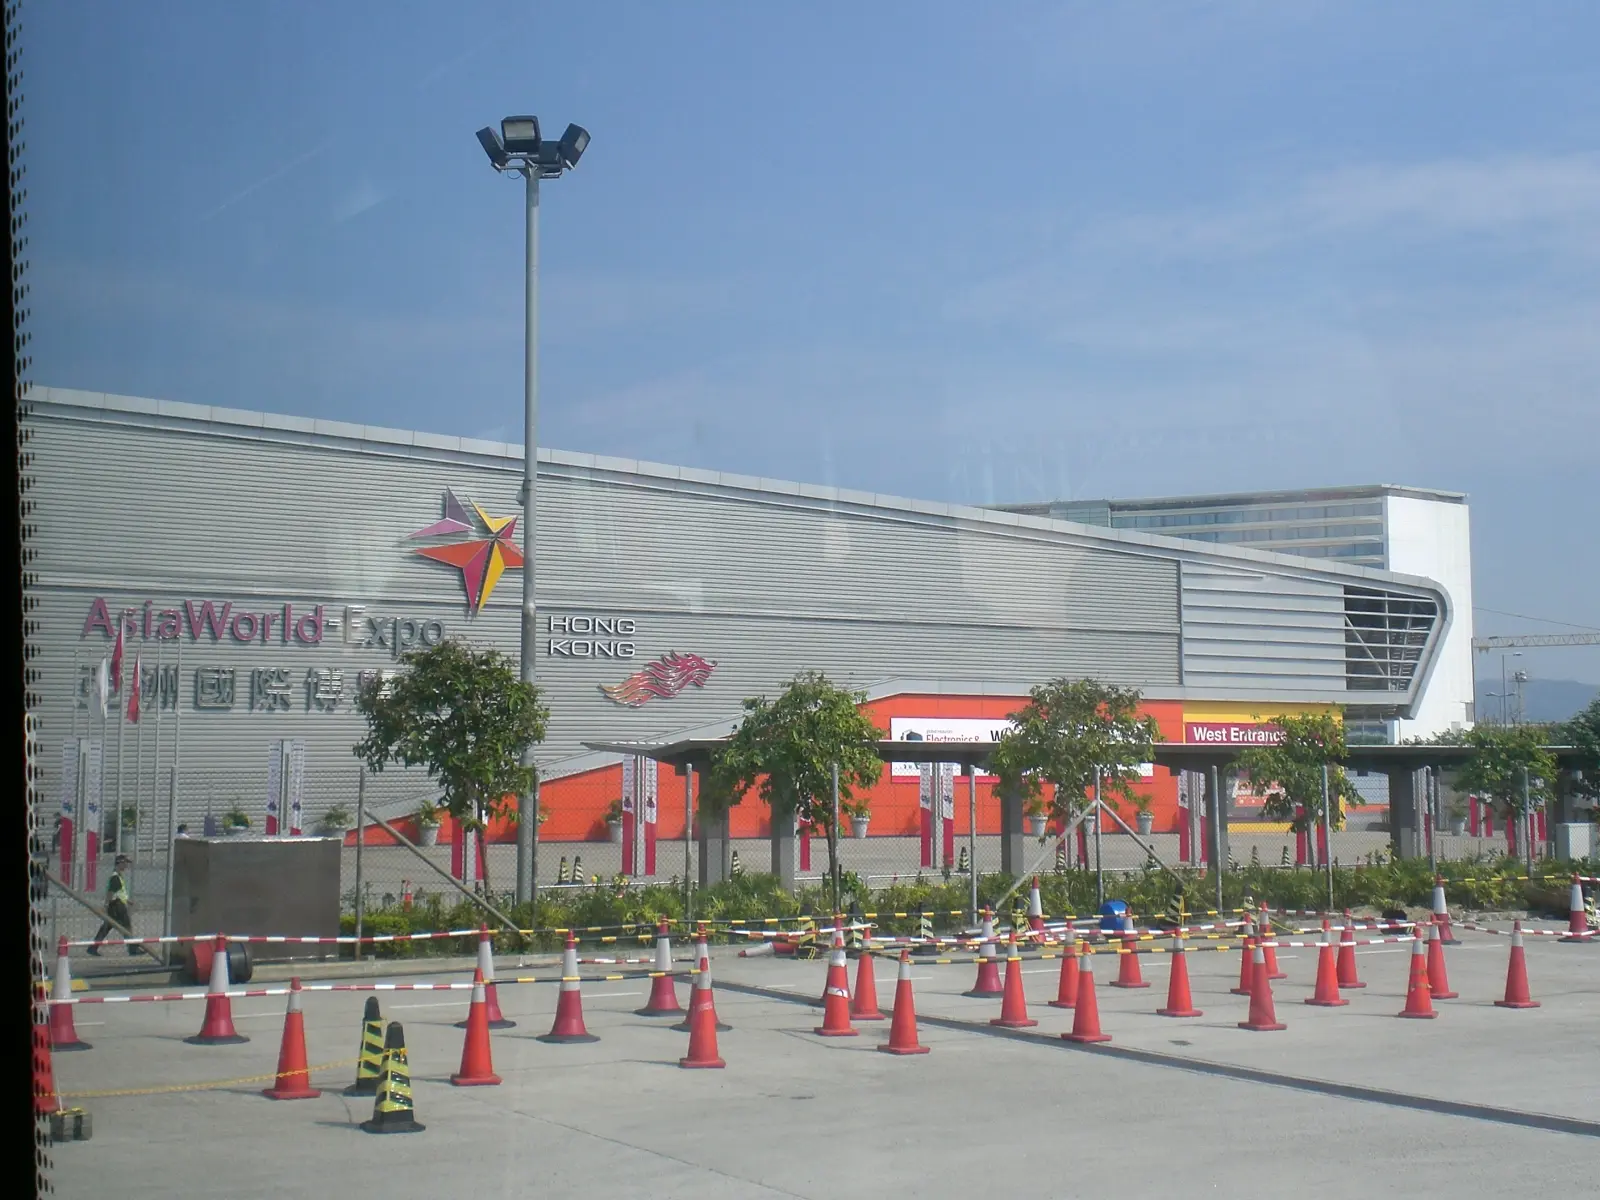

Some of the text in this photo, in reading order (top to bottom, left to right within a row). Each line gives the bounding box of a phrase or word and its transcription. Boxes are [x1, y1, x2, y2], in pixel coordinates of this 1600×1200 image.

[84, 596, 444, 655] AsiaWorld-Expo
[549, 615, 636, 634] HONG
[549, 639, 636, 657] KONG
[1193, 727, 1227, 741] West
